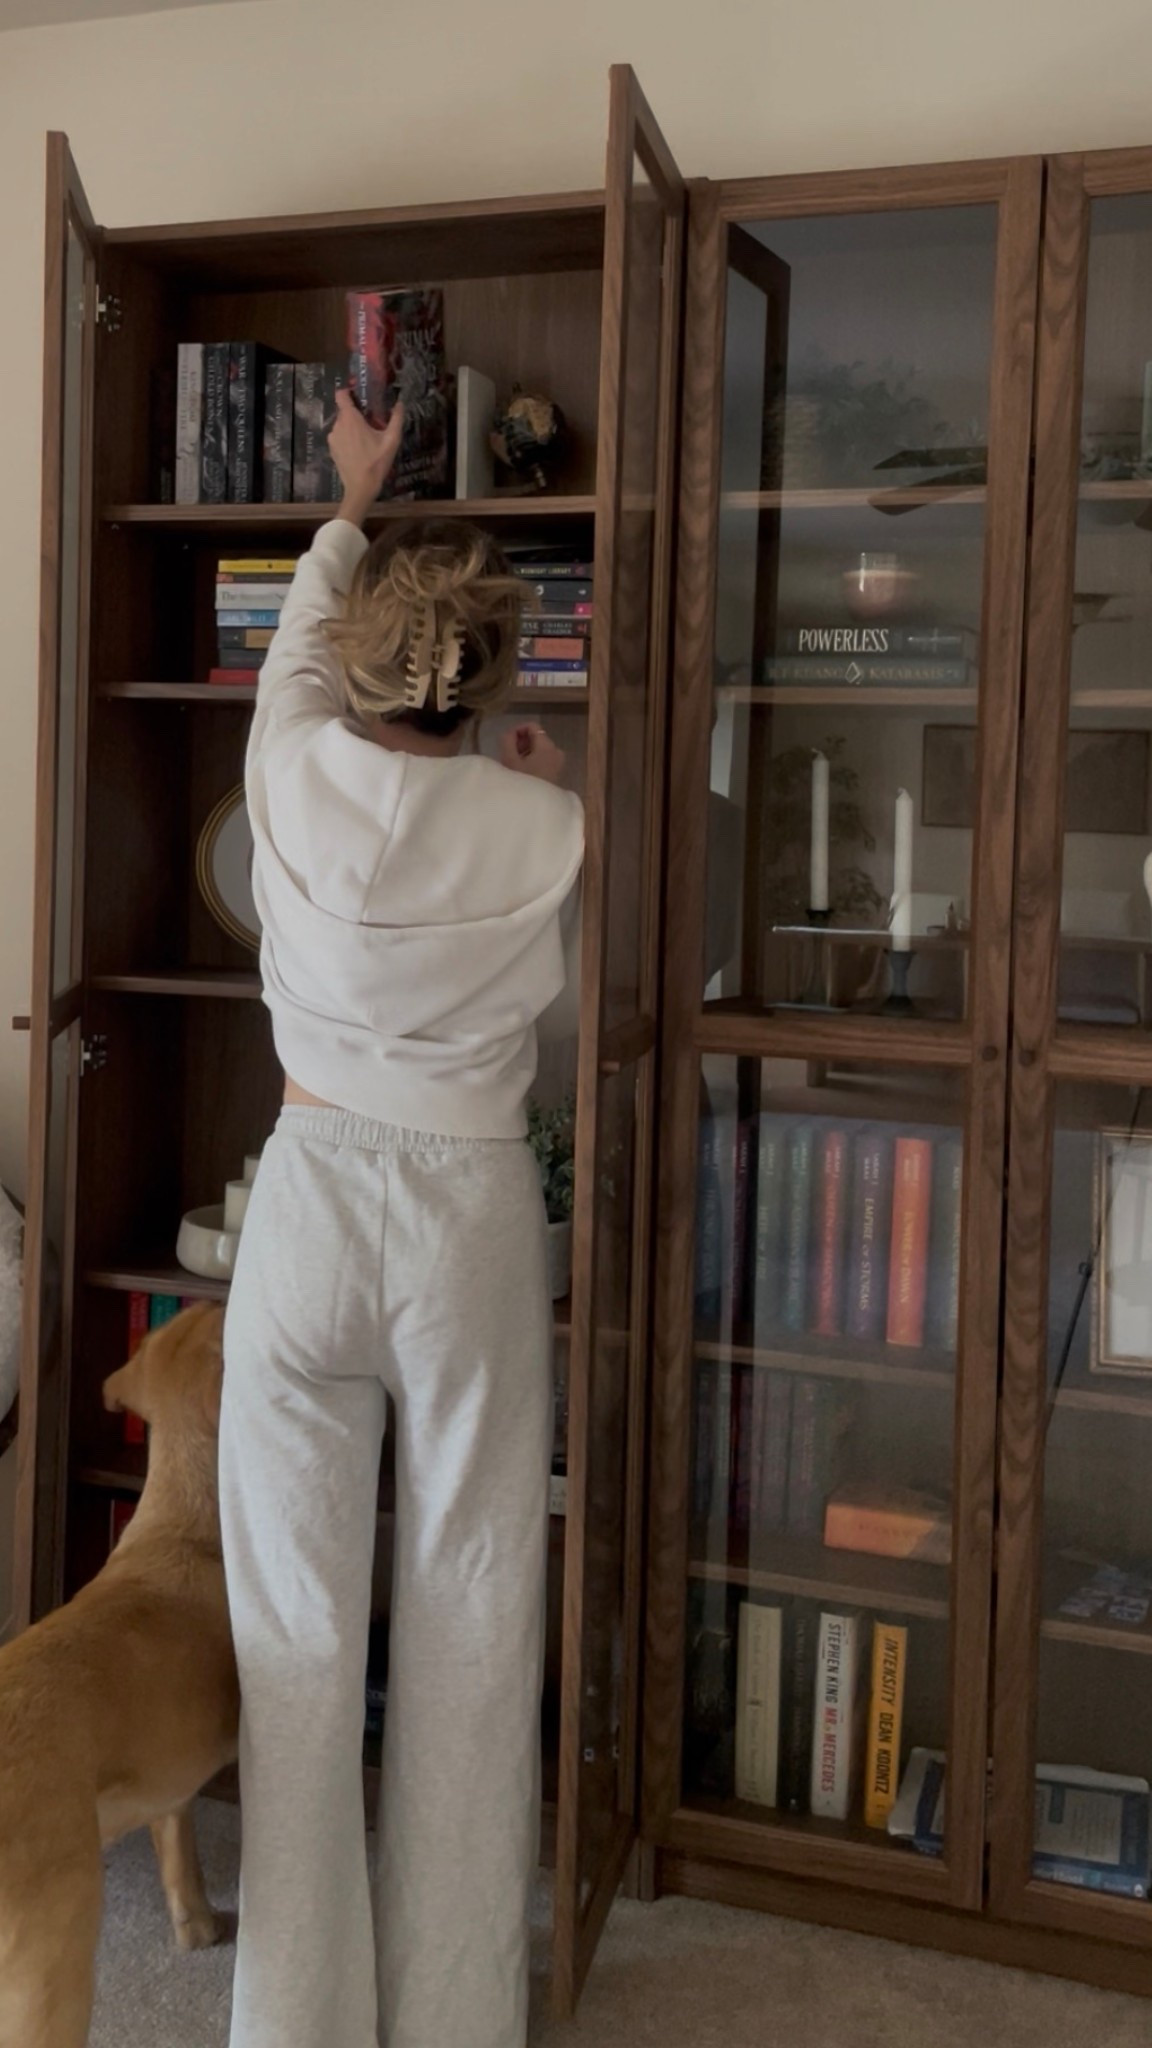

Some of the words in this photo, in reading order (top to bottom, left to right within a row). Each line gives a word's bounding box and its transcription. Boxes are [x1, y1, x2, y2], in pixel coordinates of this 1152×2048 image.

[797, 627, 889, 652] POWERLESS
[862, 1197, 874, 1240] EMPIRE
[859, 1260, 872, 1310] STORMS
[826, 1623, 841, 1673] STEPHEN
[825, 1676, 839, 1704] KING
[881, 1638, 899, 1706] INTENSITY
[878, 1712, 894, 1743] DEAN
[821, 1733, 837, 1793] MERCEDES
[874, 1748, 890, 1794] KOONTZ
